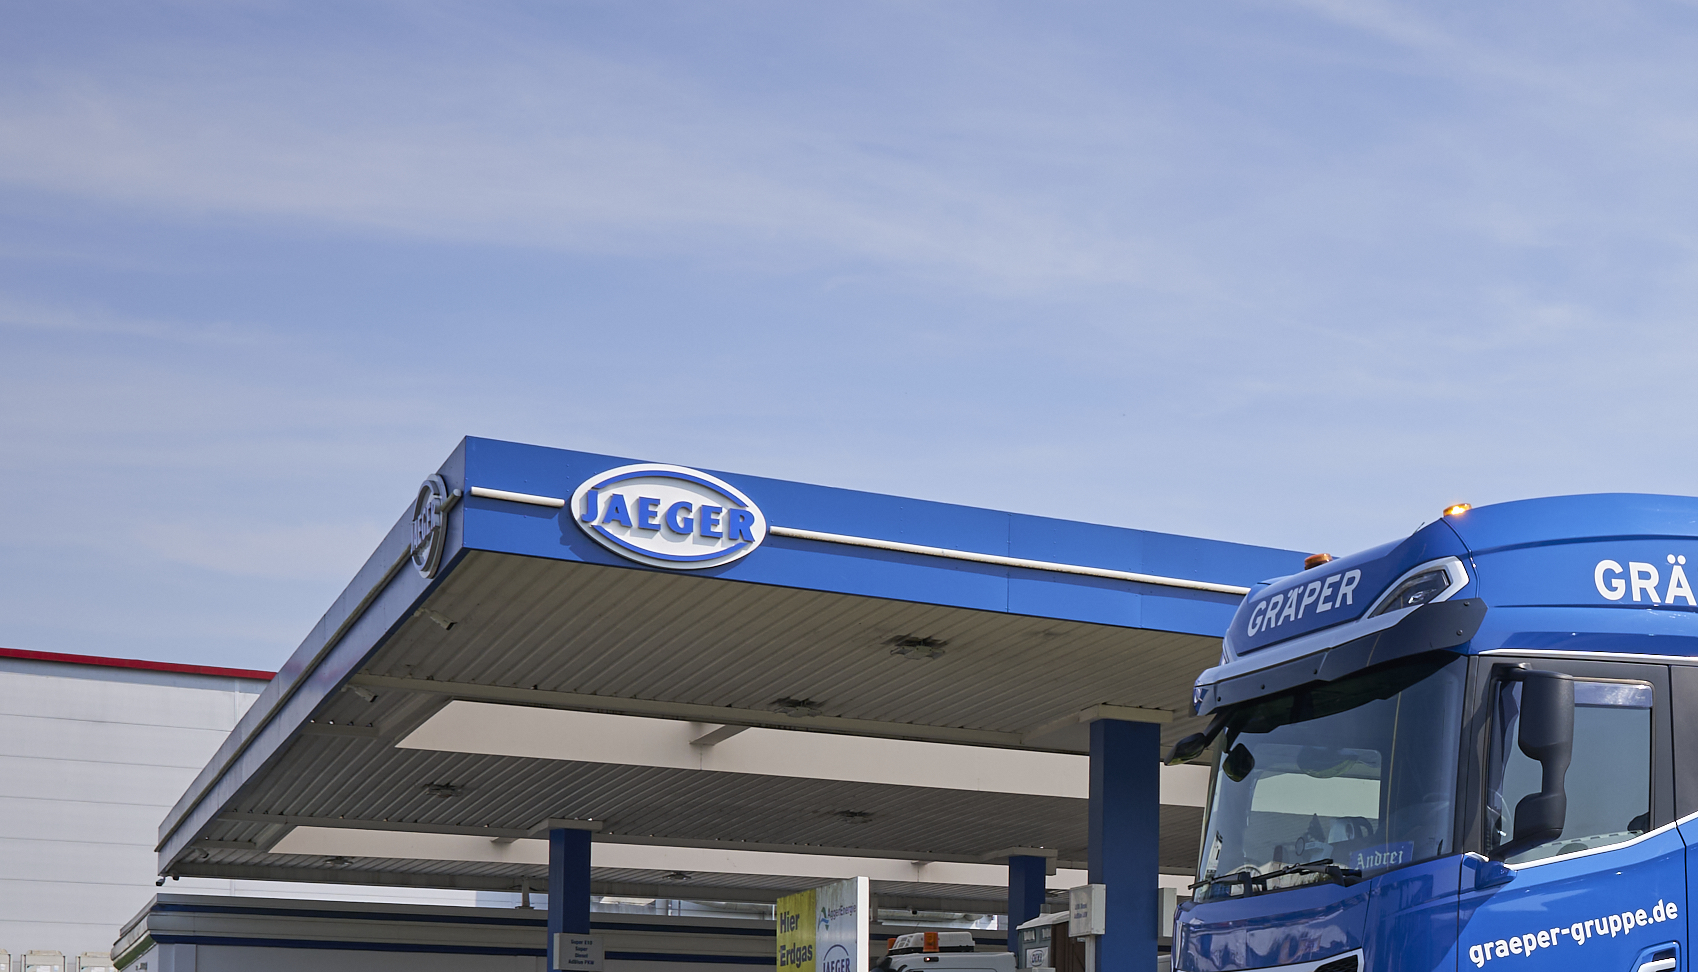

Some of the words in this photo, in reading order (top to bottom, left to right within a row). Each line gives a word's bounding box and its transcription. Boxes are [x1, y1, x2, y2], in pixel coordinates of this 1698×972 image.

[581, 489, 756, 543] JAEGER
[1247, 569, 1362, 637] GRÄPER
[1355, 845, 1404, 871] Andrei
[779, 910, 800, 934] Hier
[1469, 899, 1679, 969] graeper-gruppe.de
[779, 942, 813, 968] Erdgas
